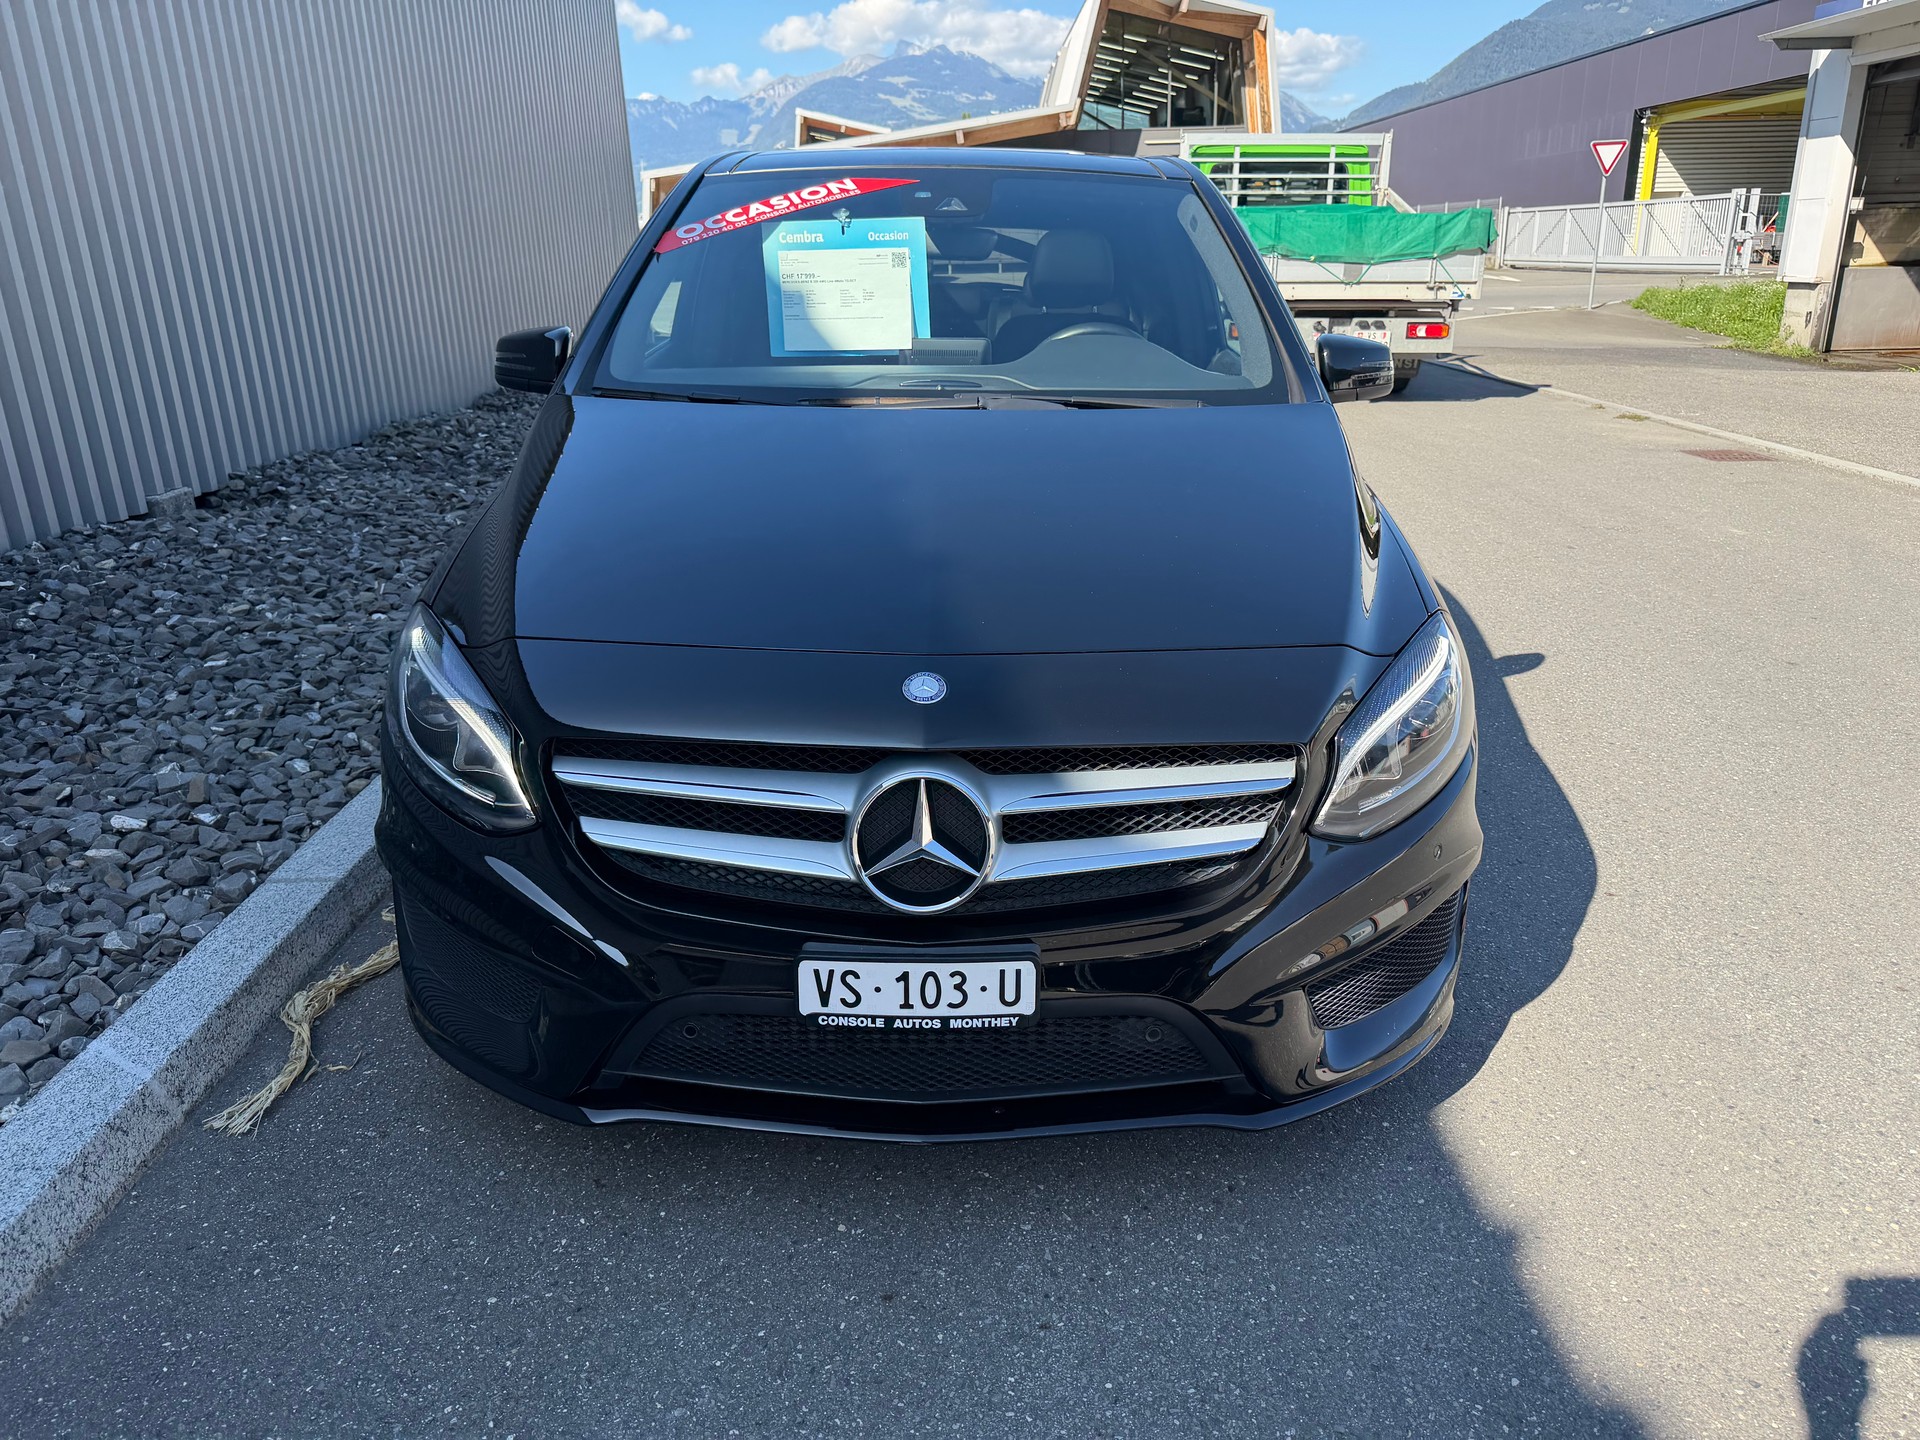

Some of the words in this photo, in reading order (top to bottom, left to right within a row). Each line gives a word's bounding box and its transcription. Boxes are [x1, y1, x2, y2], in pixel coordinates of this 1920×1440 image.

[675, 177, 858, 239] OCCASION
[681, 235, 700, 245] 079
[702, 229, 720, 239] 220
[721, 224, 734, 232] 40
[735, 220, 748, 228] 00
[754, 206, 796, 221] CONSOLE
[798, 189, 861, 209] AUTOMOBILES
[778, 230, 824, 243] Cembra
[867, 231, 909, 241] Occasion
[817, 1015, 885, 1028] CONSOLE
[893, 1018, 942, 1029] AUTOS
[949, 1016, 1020, 1029] MONTHEY
